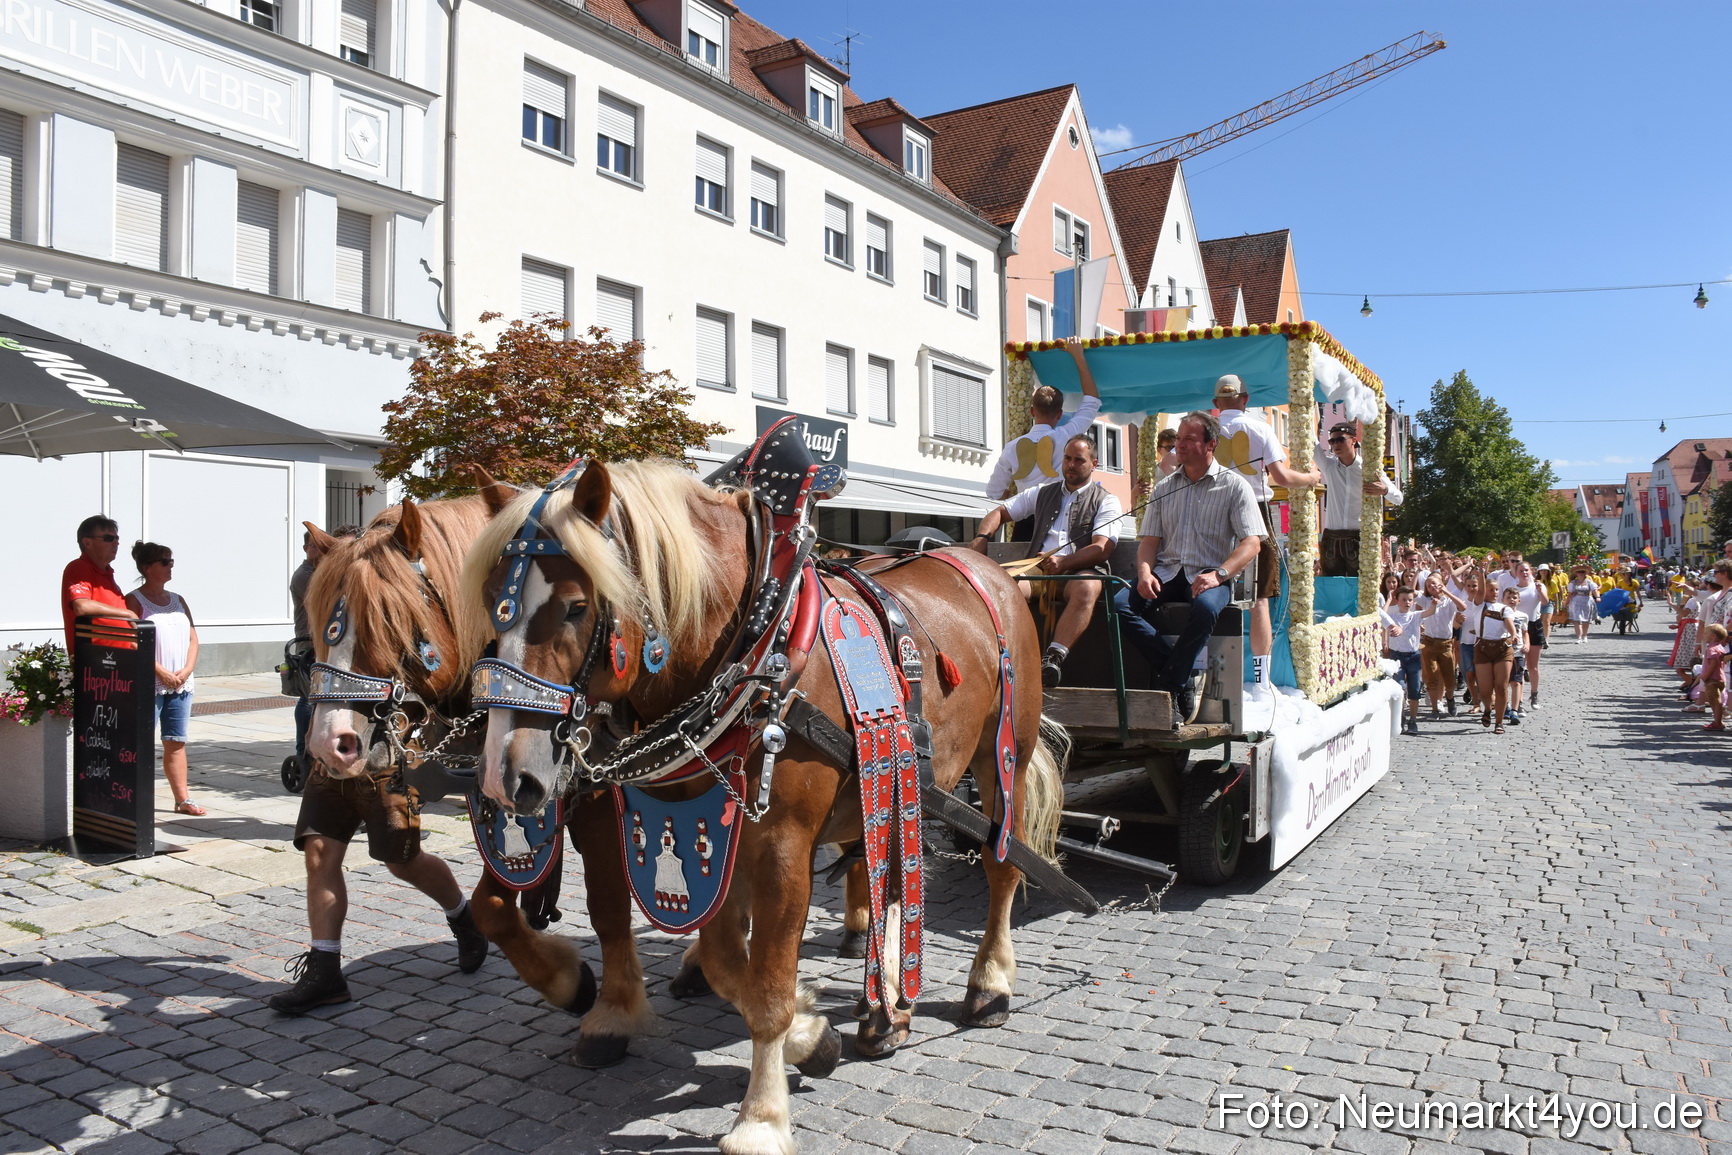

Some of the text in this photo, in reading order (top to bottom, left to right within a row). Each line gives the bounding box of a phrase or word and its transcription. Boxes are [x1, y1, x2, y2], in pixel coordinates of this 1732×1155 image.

[0, 0, 284, 126] RILLEN WEBER
[801, 422, 846, 462] hauf
[84, 666, 133, 701] Happy Hour
